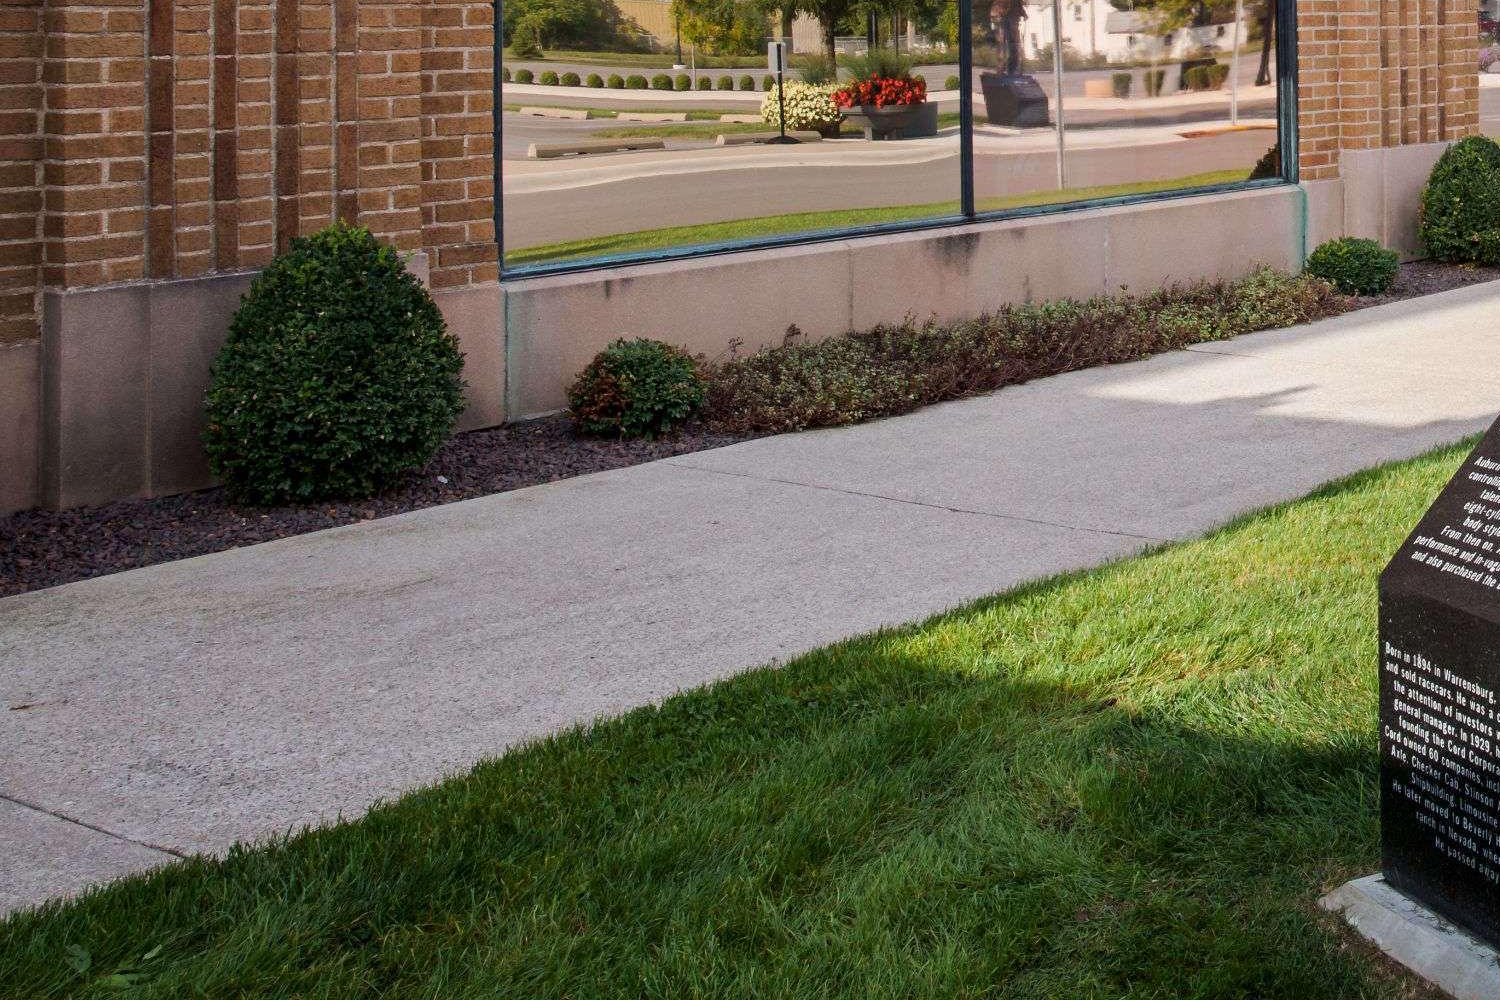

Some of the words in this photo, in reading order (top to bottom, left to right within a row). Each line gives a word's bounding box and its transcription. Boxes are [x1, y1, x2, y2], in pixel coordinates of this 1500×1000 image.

[1440, 524, 1462, 539] From
[1462, 532, 1481, 546] then
[1462, 515, 1483, 532] body
[1412, 535, 1459, 556] performance
[1458, 550, 1476, 562] and
[1410, 550, 1428, 562] and
[1425, 554, 1443, 568] also
[1440, 561, 1483, 582] purchased
[1481, 574, 1497, 587] the
[1384, 640, 1402, 659] Born
[1412, 654, 1431, 672] 1894
[1385, 660, 1398, 675] and
[1400, 668, 1416, 683] sold
[1469, 700, 1485, 715] was
[1393, 679, 1405, 694] the
[1407, 688, 1441, 711] attention
[1455, 708, 1492, 736] investors
[1393, 698, 1421, 718] general
